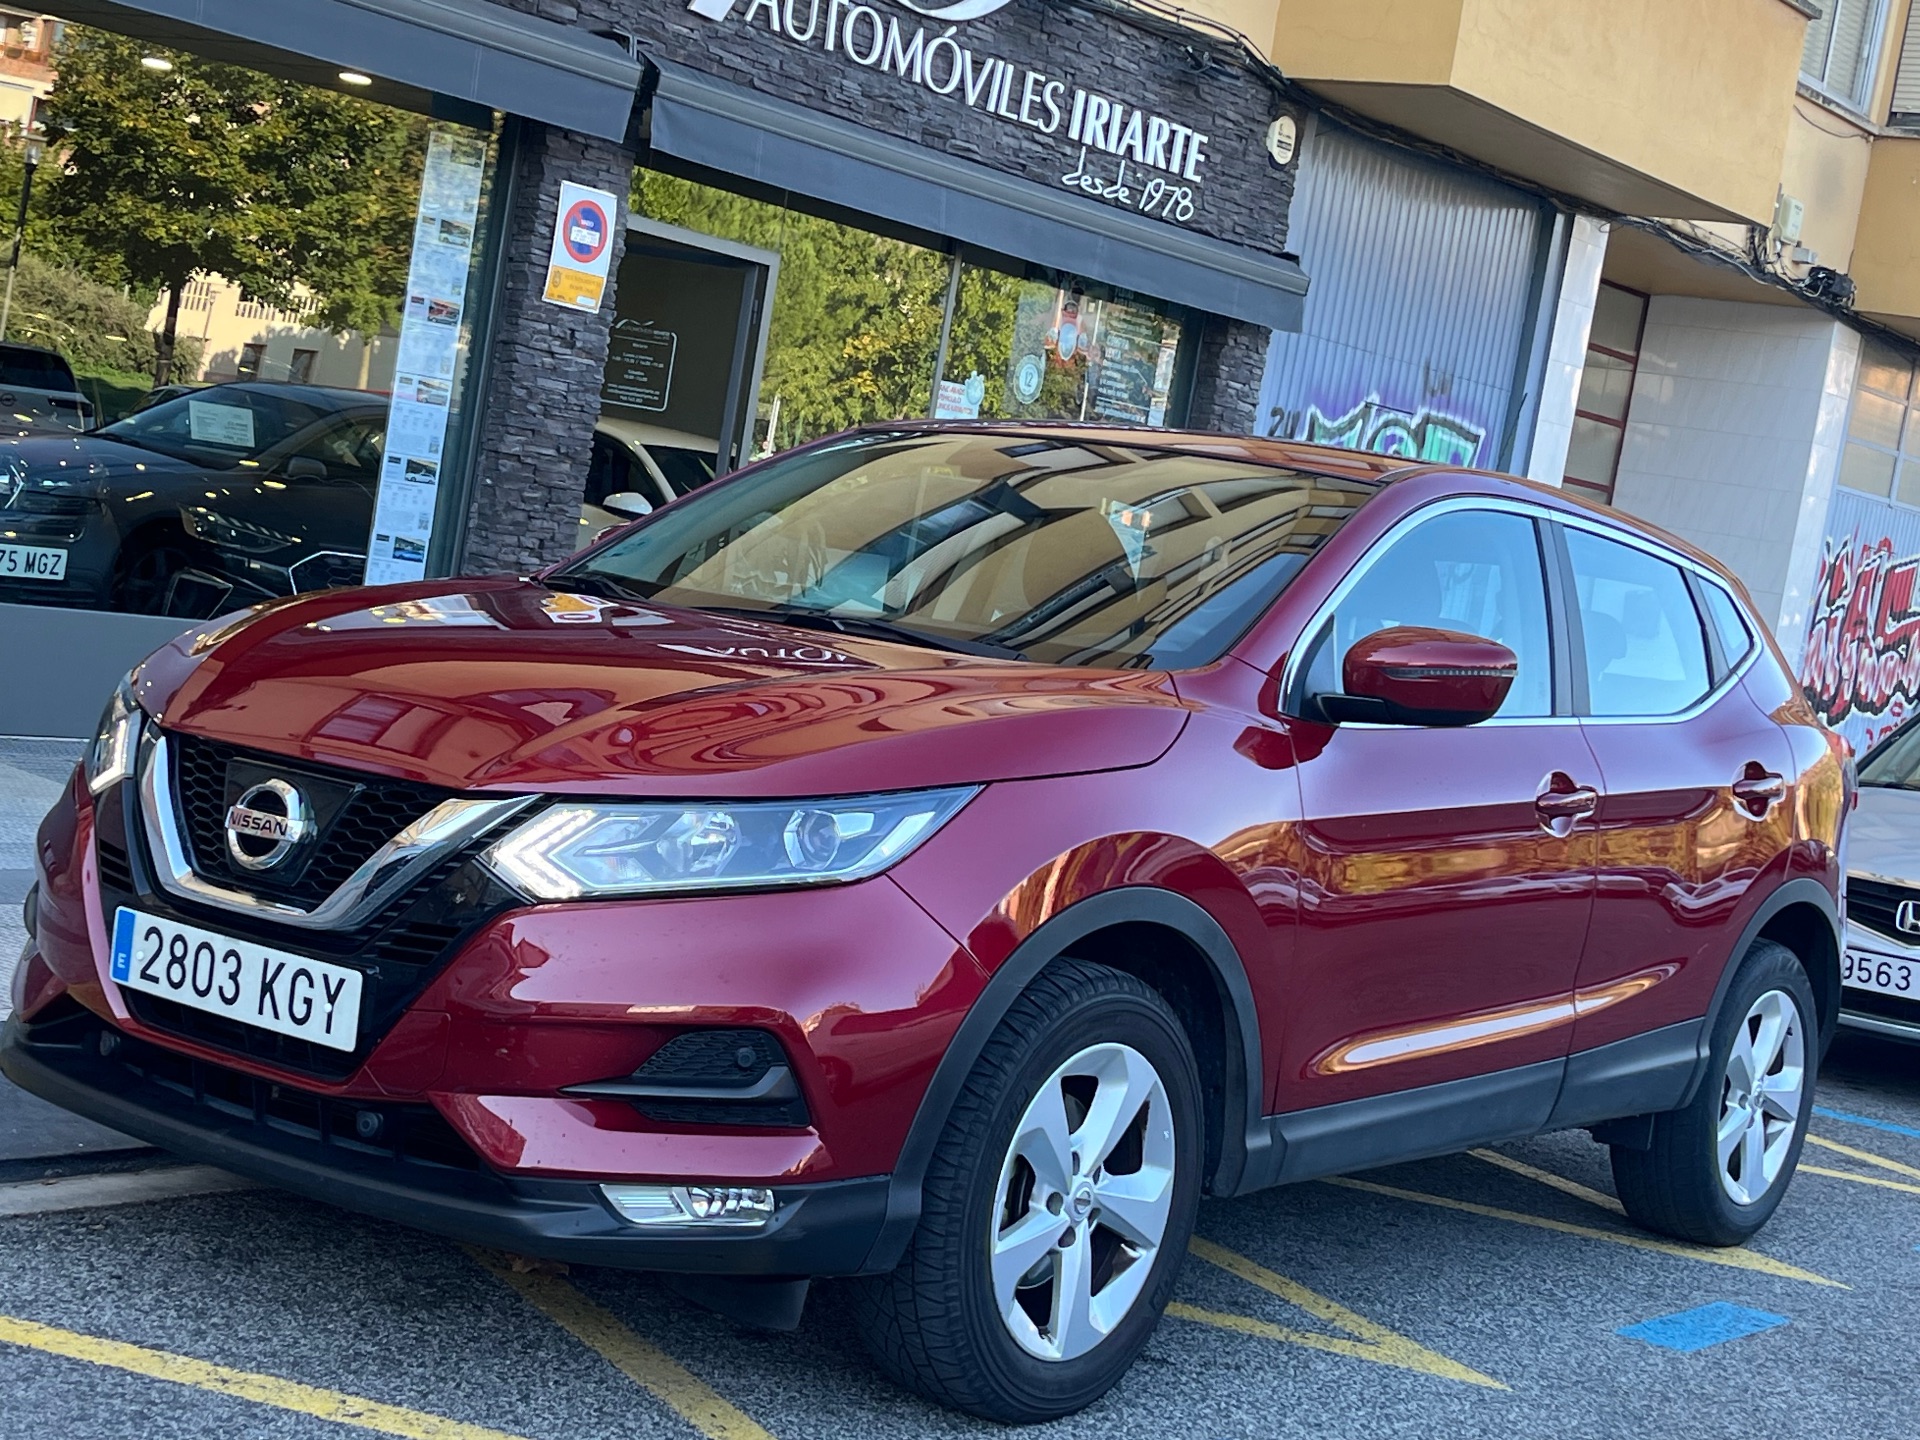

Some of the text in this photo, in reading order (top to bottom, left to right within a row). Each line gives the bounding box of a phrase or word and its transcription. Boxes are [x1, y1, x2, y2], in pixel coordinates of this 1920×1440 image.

[1067, 89, 1209, 182] IRIARTE
[1061, 146, 1194, 221] desde 1978
[24, 551, 62, 576] MGZ
[229, 810, 289, 836] NISSAN
[117, 926, 346, 1035] E 2803 KGY
[1843, 954, 1912, 992] 9563
